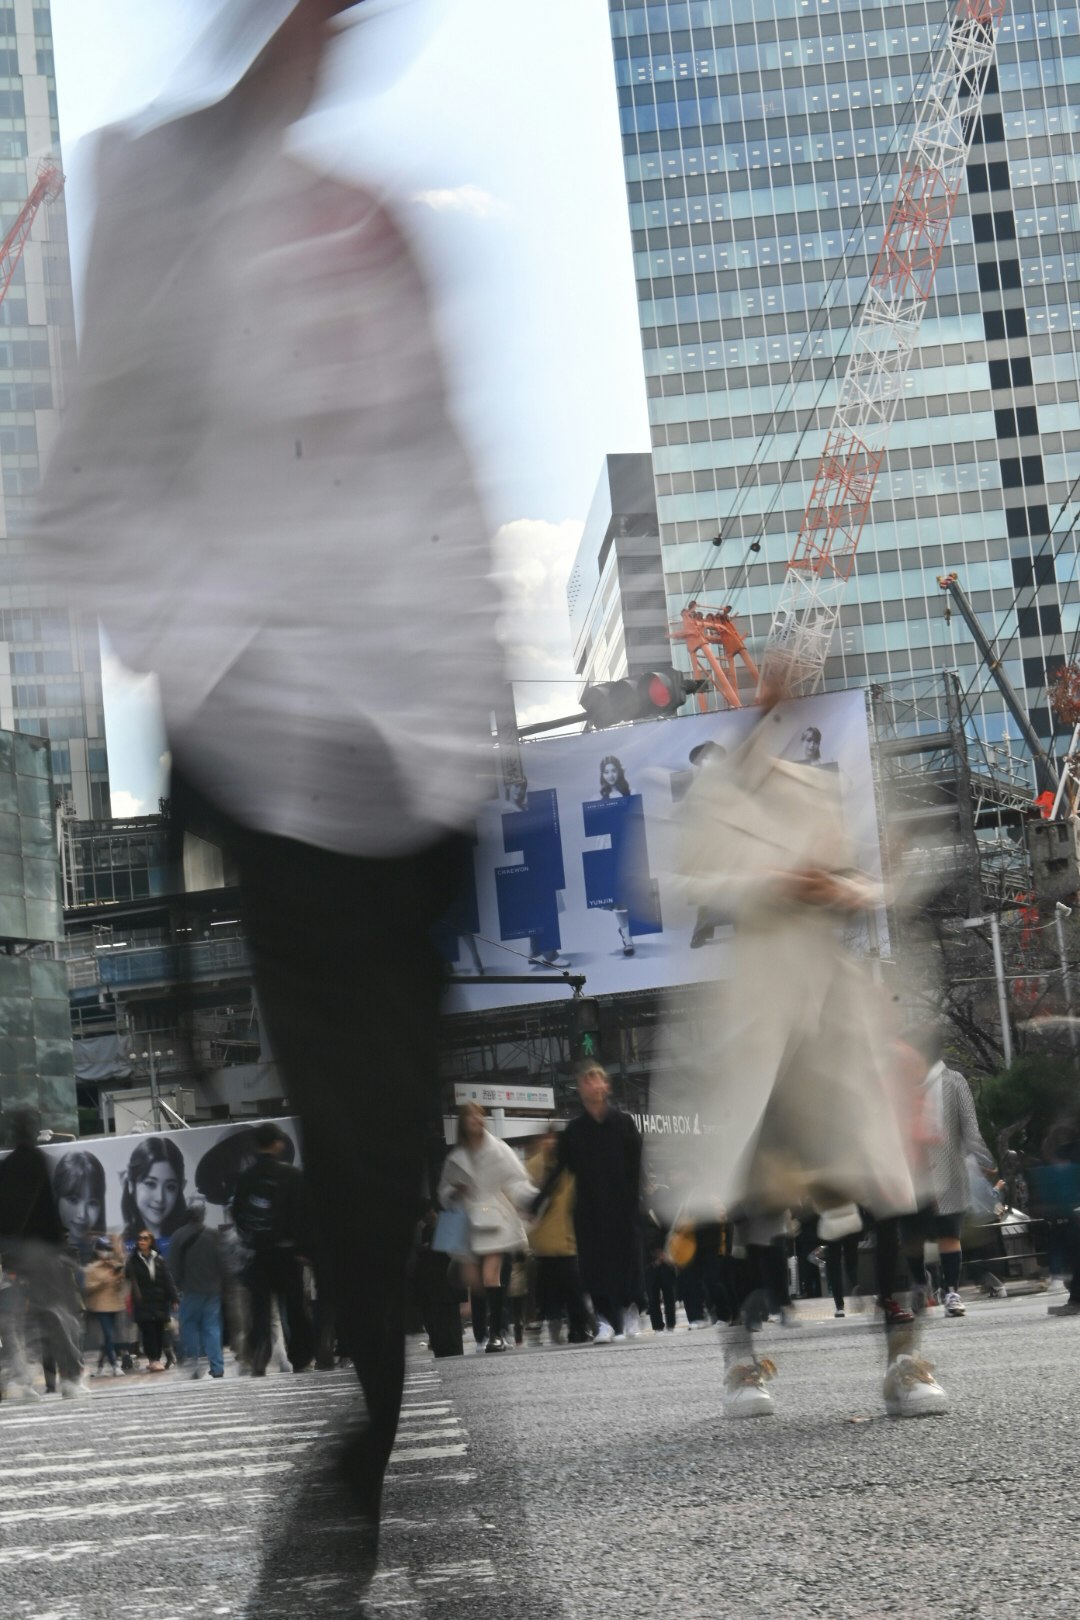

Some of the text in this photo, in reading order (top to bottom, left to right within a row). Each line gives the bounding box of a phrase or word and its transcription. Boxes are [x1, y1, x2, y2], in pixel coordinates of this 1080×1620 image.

[589, 898, 614, 906] YUNJIN
[643, 1114, 671, 1134] HACHI
[672, 1115, 690, 1134] BOX
